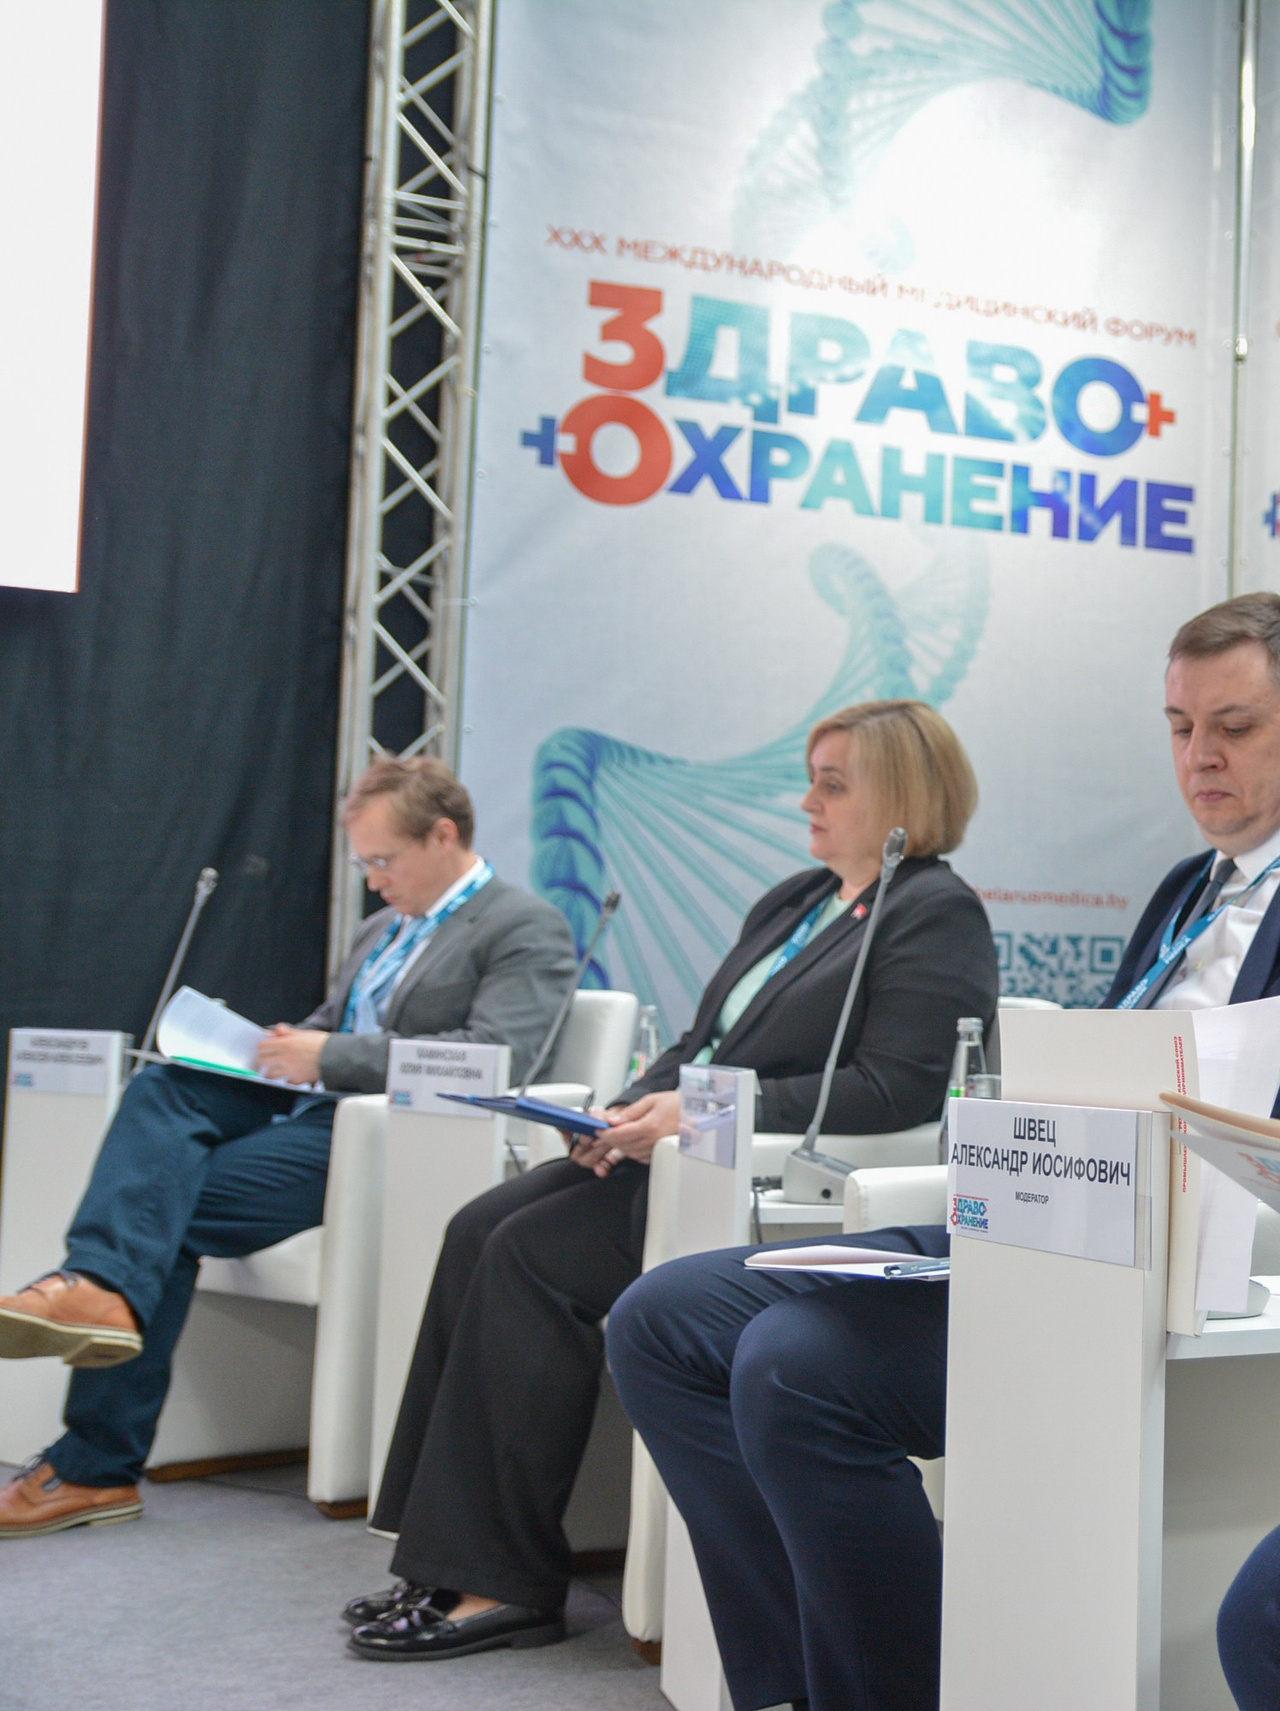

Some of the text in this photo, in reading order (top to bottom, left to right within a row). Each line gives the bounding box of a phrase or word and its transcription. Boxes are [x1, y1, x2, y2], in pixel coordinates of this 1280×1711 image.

[1104, 316, 1197, 349] ФОРУМ
[1013, 1116, 1057, 1147] ШВЕЦ
[950, 1143, 1131, 1186] АЛЕКСАНДР ИОСИФОВИЧ
[1015, 1191, 1049, 1204] МОДЕРАТОР
